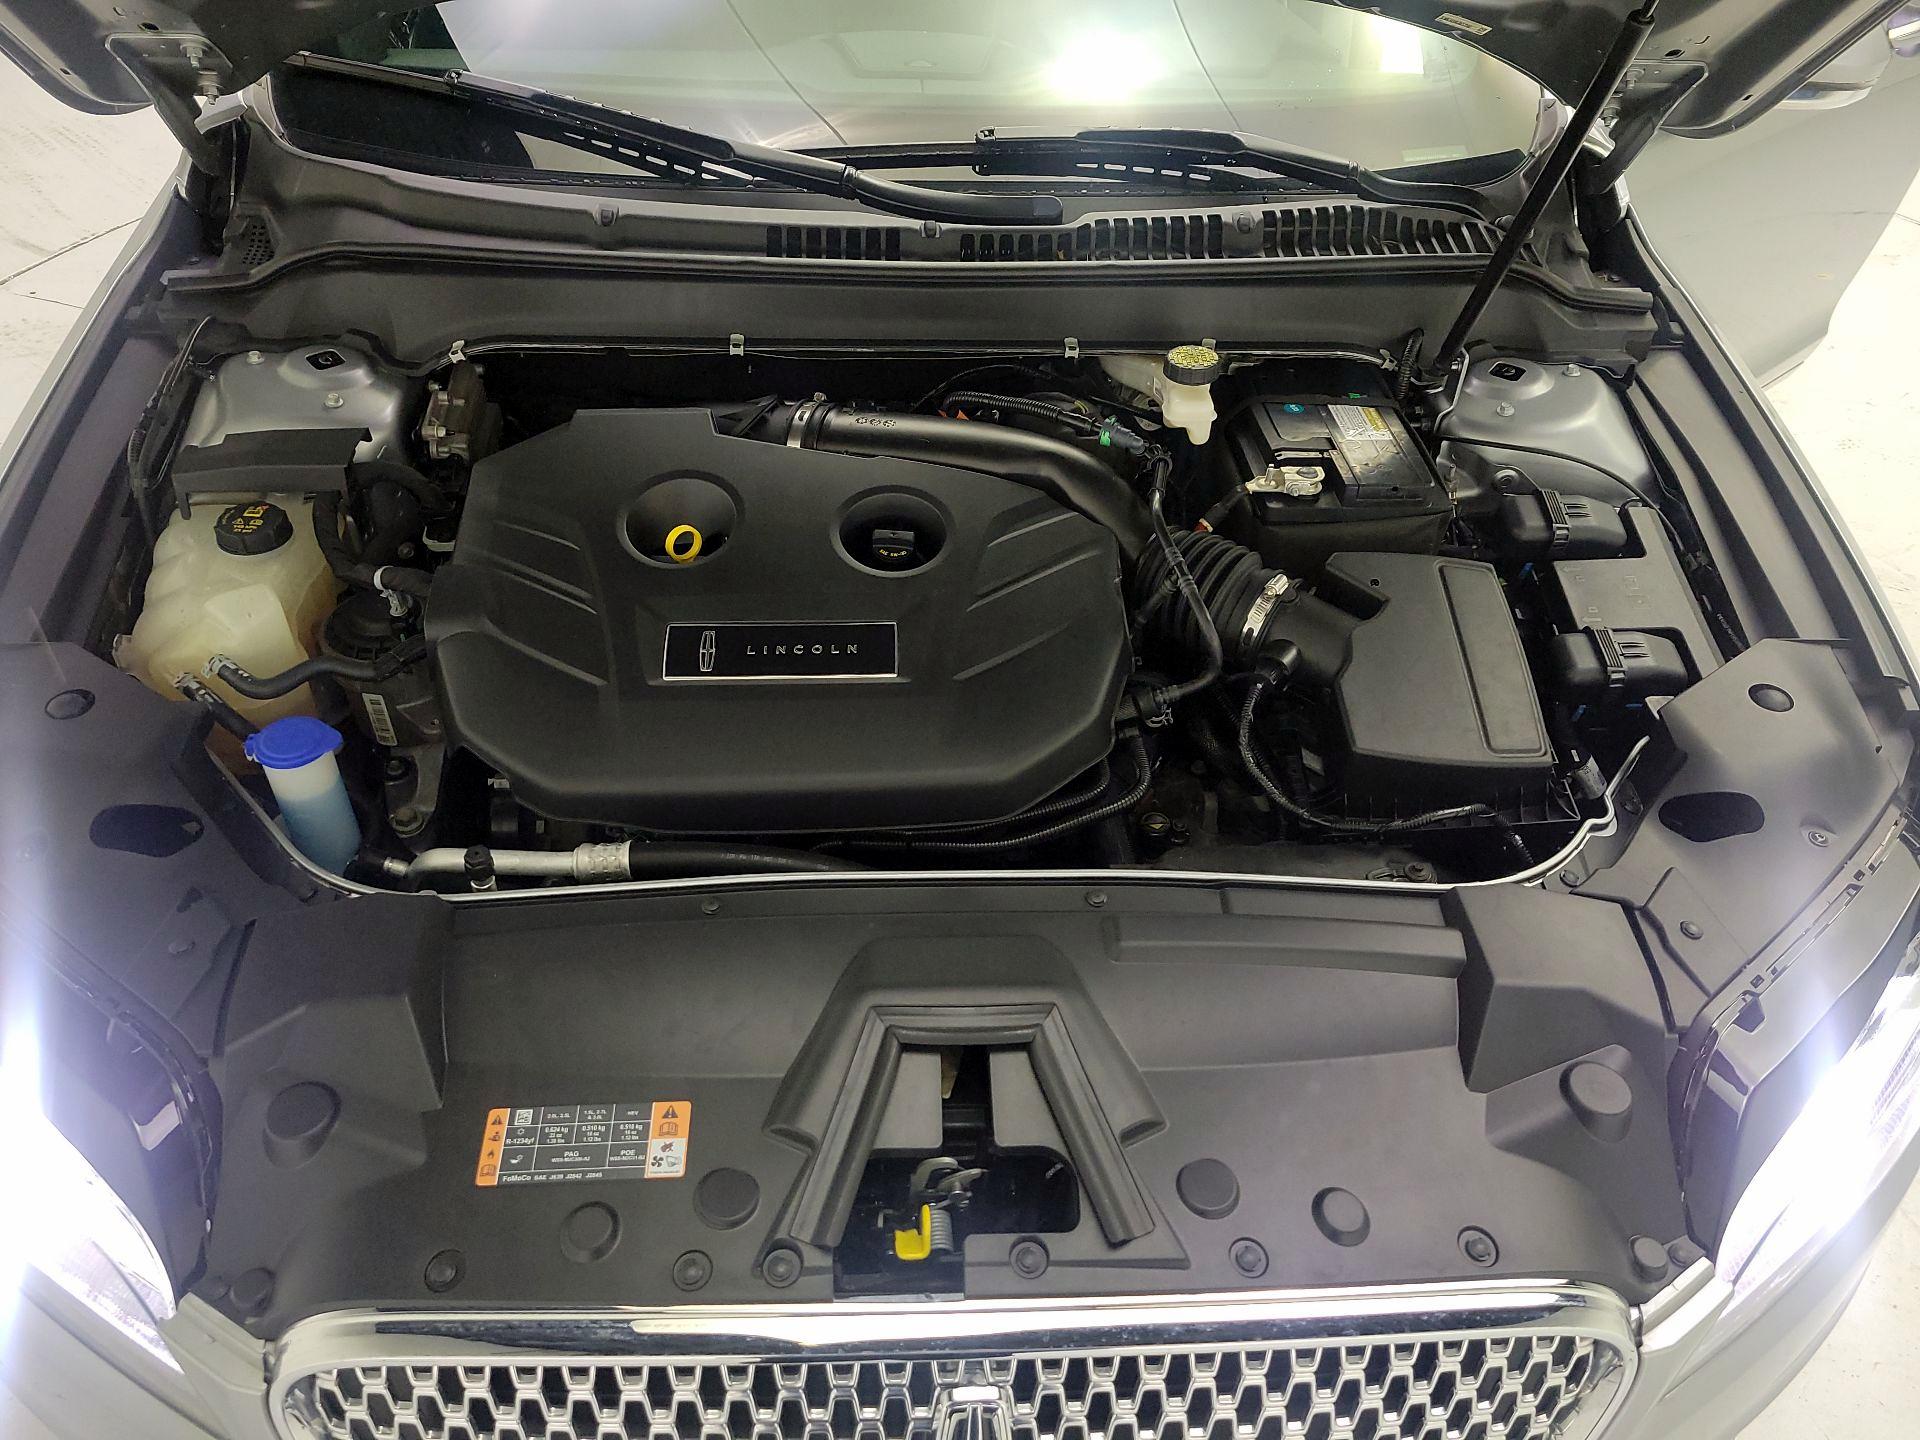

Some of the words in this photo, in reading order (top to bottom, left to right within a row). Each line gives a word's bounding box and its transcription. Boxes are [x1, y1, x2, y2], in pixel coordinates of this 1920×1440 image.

[746, 644, 859, 655] LINCOLN
[505, 1137, 535, 1145] R-1234yf
[502, 1174, 531, 1183] FoMoCo
